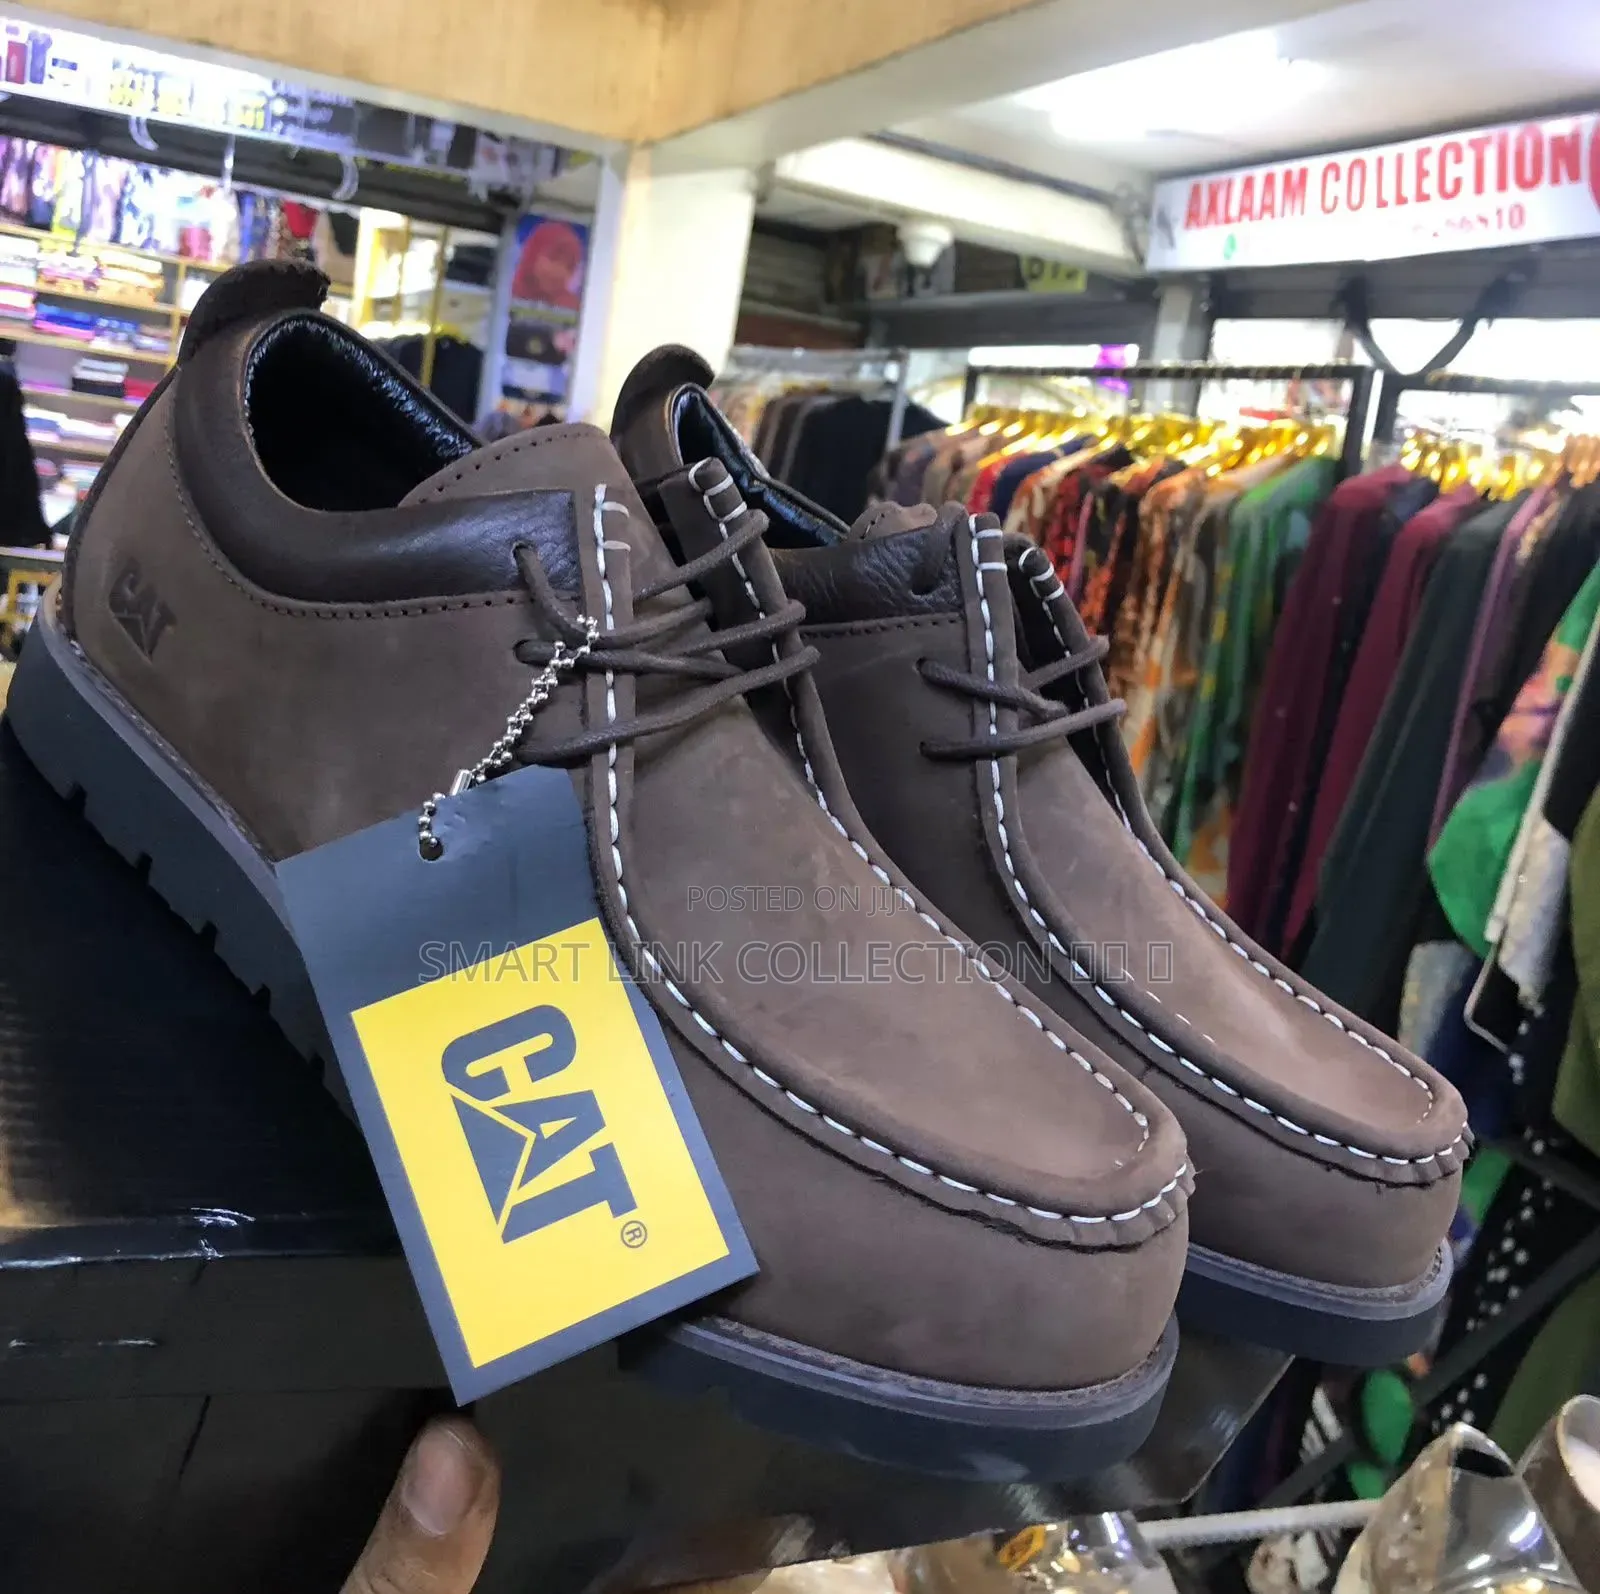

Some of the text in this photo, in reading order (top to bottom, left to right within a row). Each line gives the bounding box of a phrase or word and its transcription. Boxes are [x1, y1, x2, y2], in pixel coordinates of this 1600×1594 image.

[1320, 119, 1581, 214] COLLECTION
[108, 558, 178, 664] CAT
[441, 1004, 638, 1244] CAT
